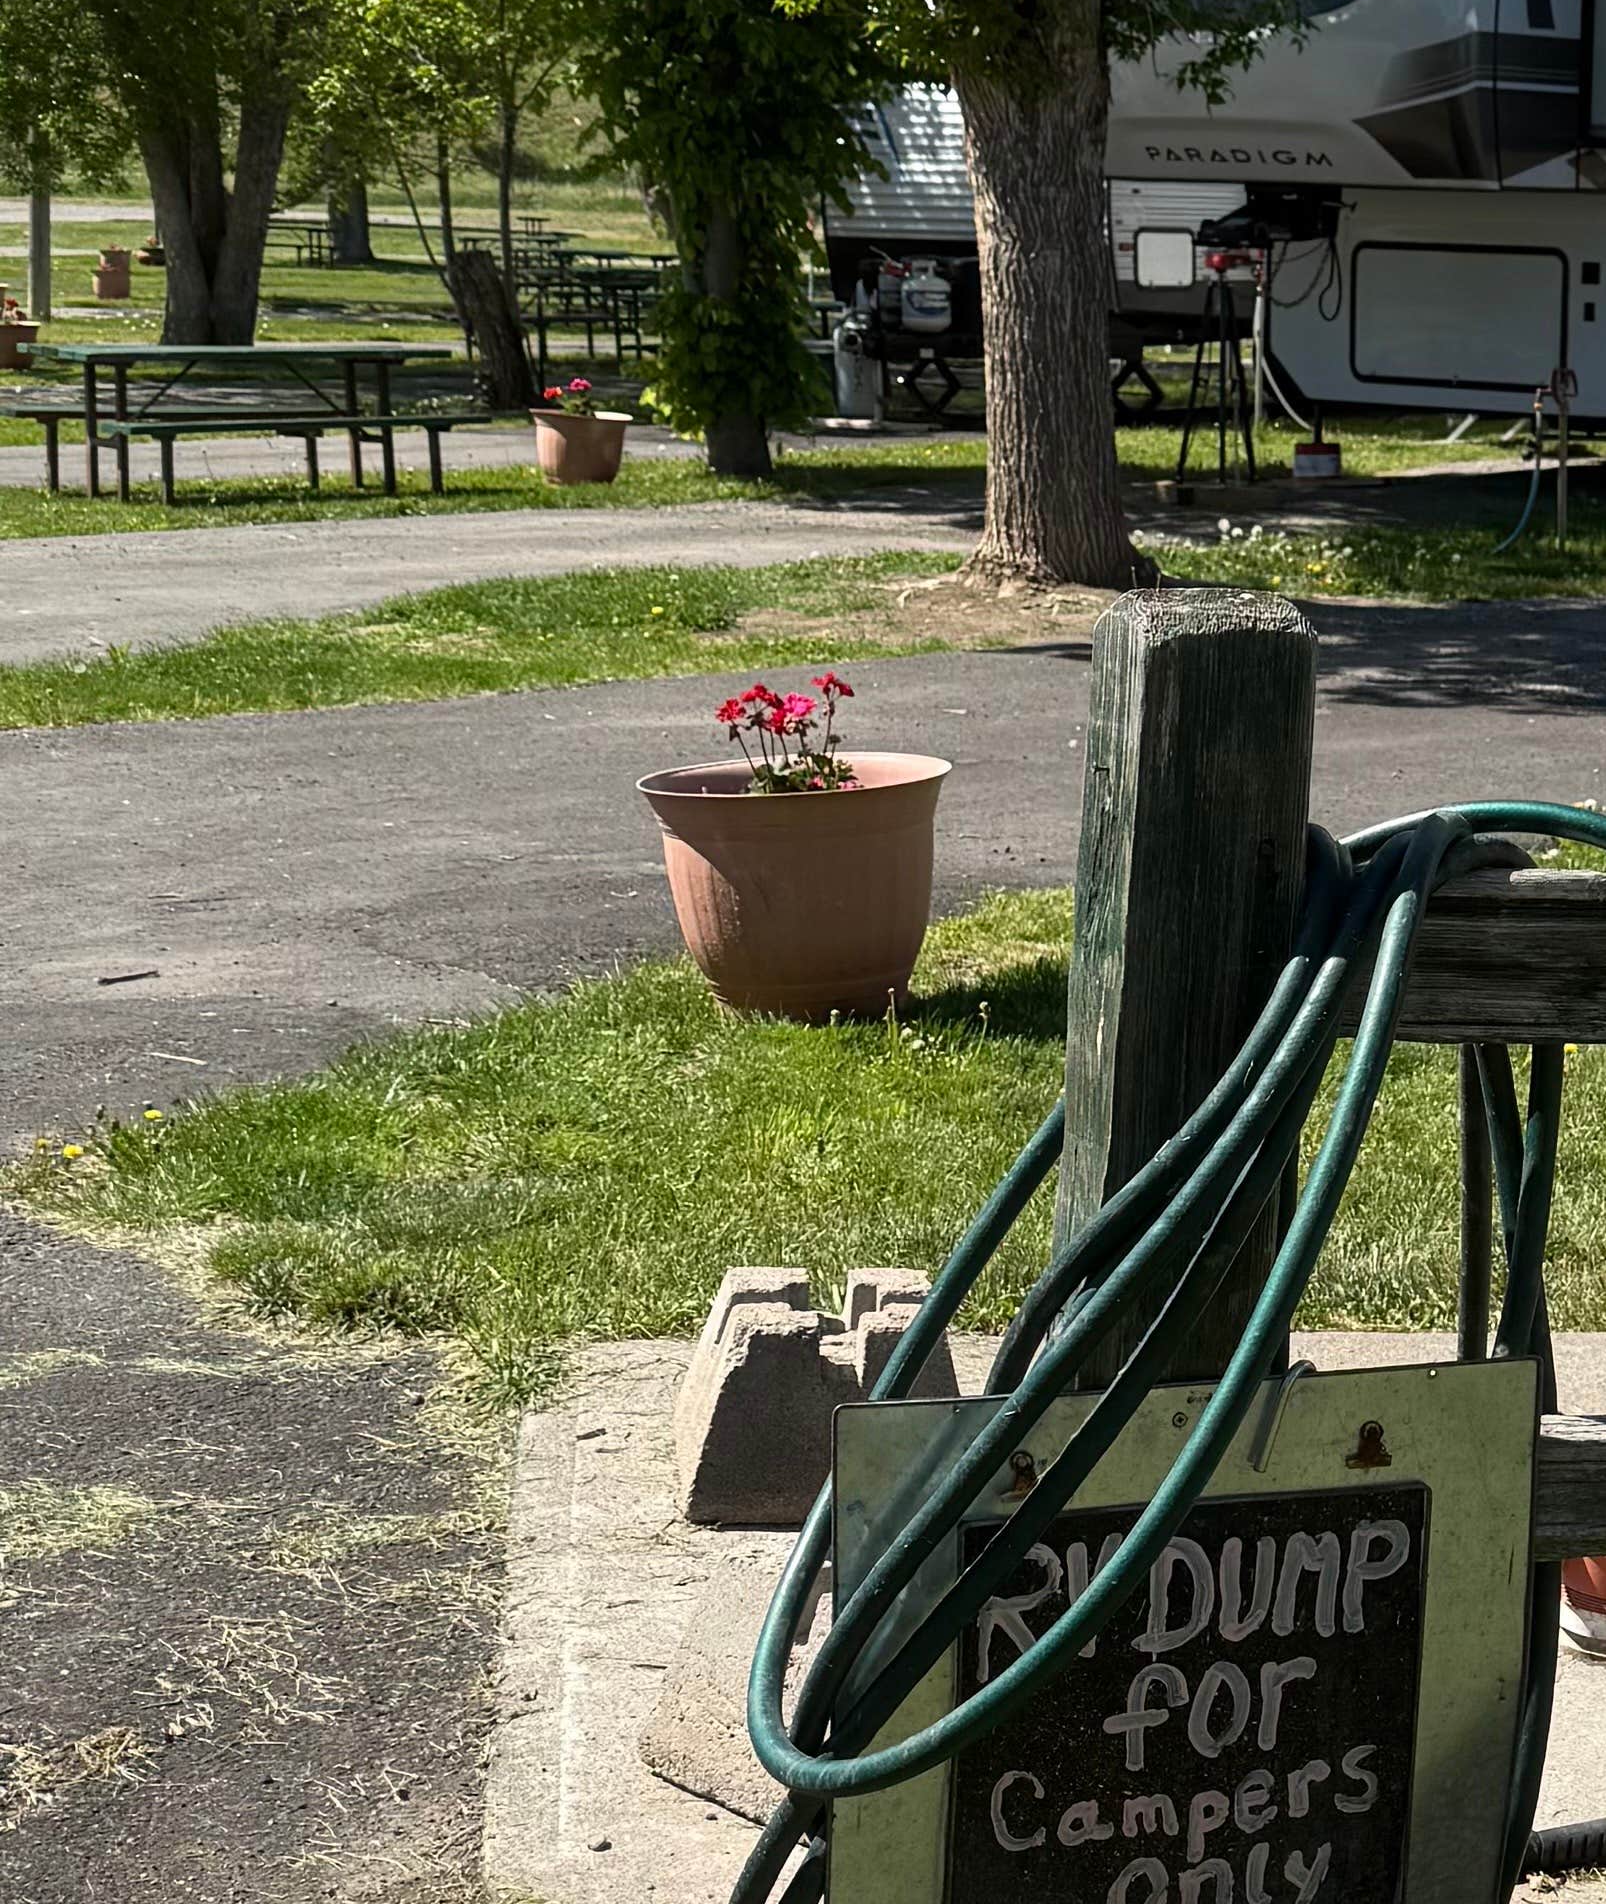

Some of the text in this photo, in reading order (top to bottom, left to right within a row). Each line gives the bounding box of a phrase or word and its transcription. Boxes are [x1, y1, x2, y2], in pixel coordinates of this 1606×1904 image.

[1144, 145, 1333, 168] PARADIGM
[1131, 1520, 1410, 1654] DUMP
[990, 1744, 1380, 1863] Campers
